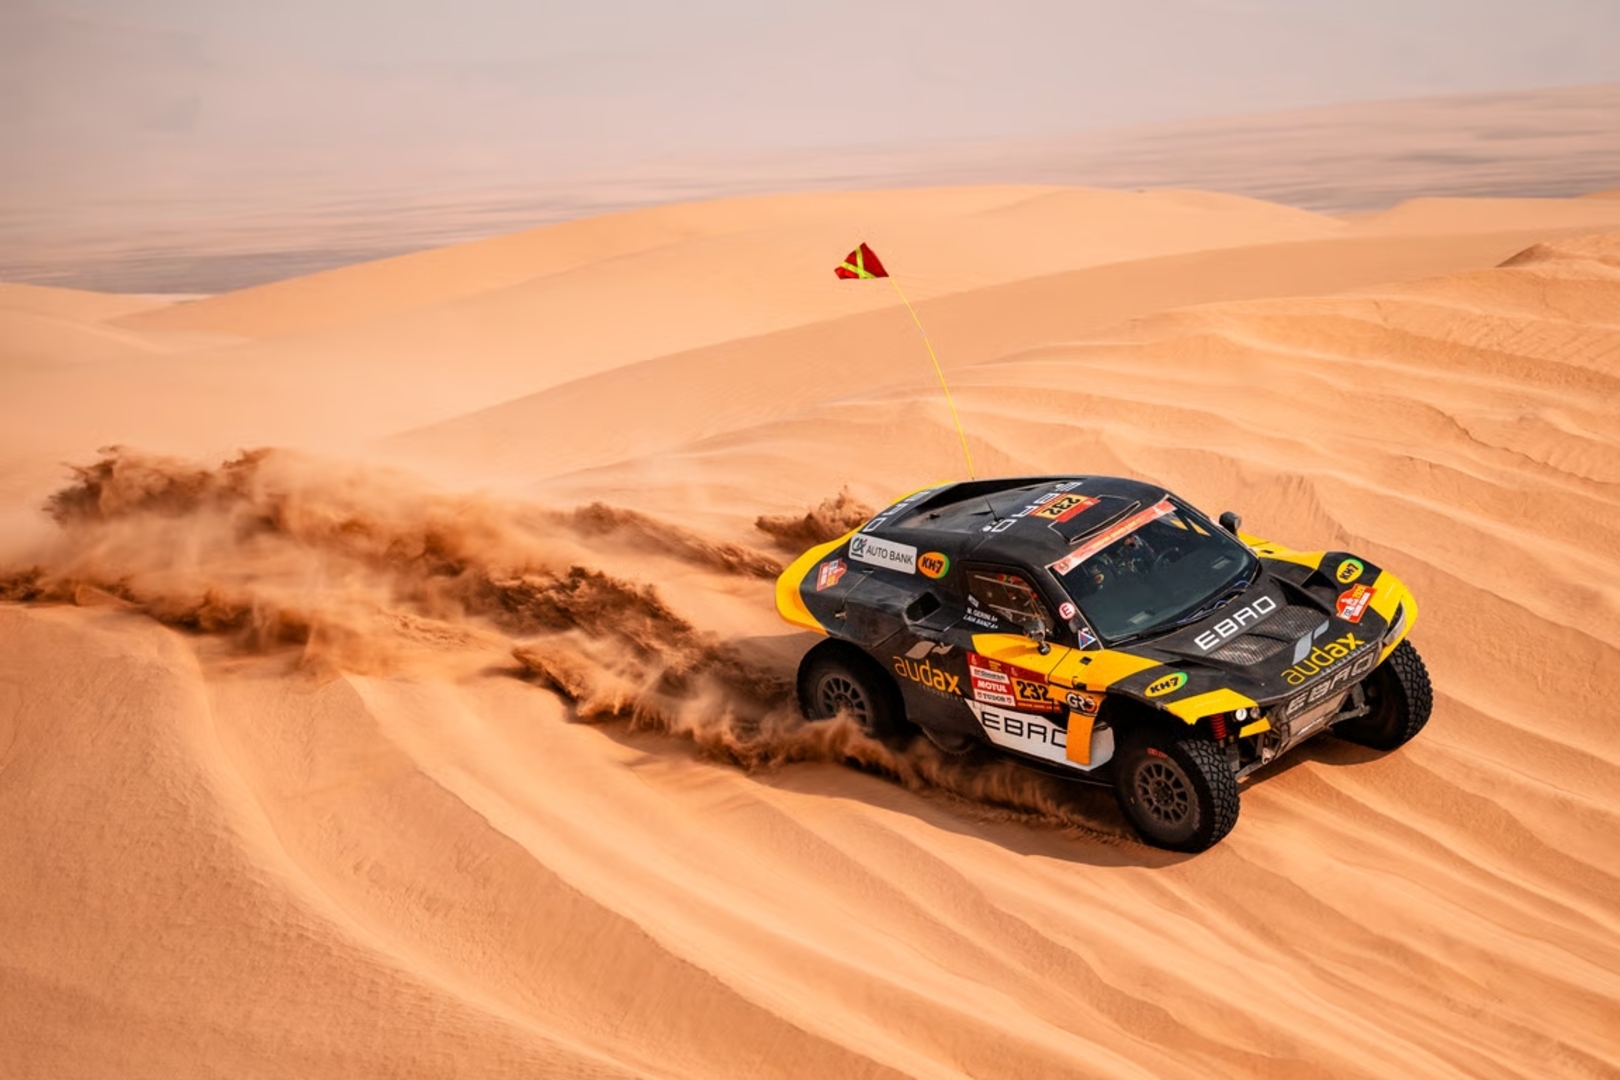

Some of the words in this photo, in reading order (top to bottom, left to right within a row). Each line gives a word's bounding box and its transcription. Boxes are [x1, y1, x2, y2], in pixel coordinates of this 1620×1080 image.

[1041, 497, 1081, 516] 232
[866, 545, 888, 559] AUTO
[889, 550, 914, 566] BANK
[1193, 595, 1277, 650] EBRO
[1280, 632, 1366, 686] audax
[892, 655, 963, 696] audax
[977, 680, 1008, 693] MOTUL
[1286, 652, 1375, 716] EBRO
[982, 692, 1006, 703] TUDOR
[1016, 680, 1054, 702] 232
